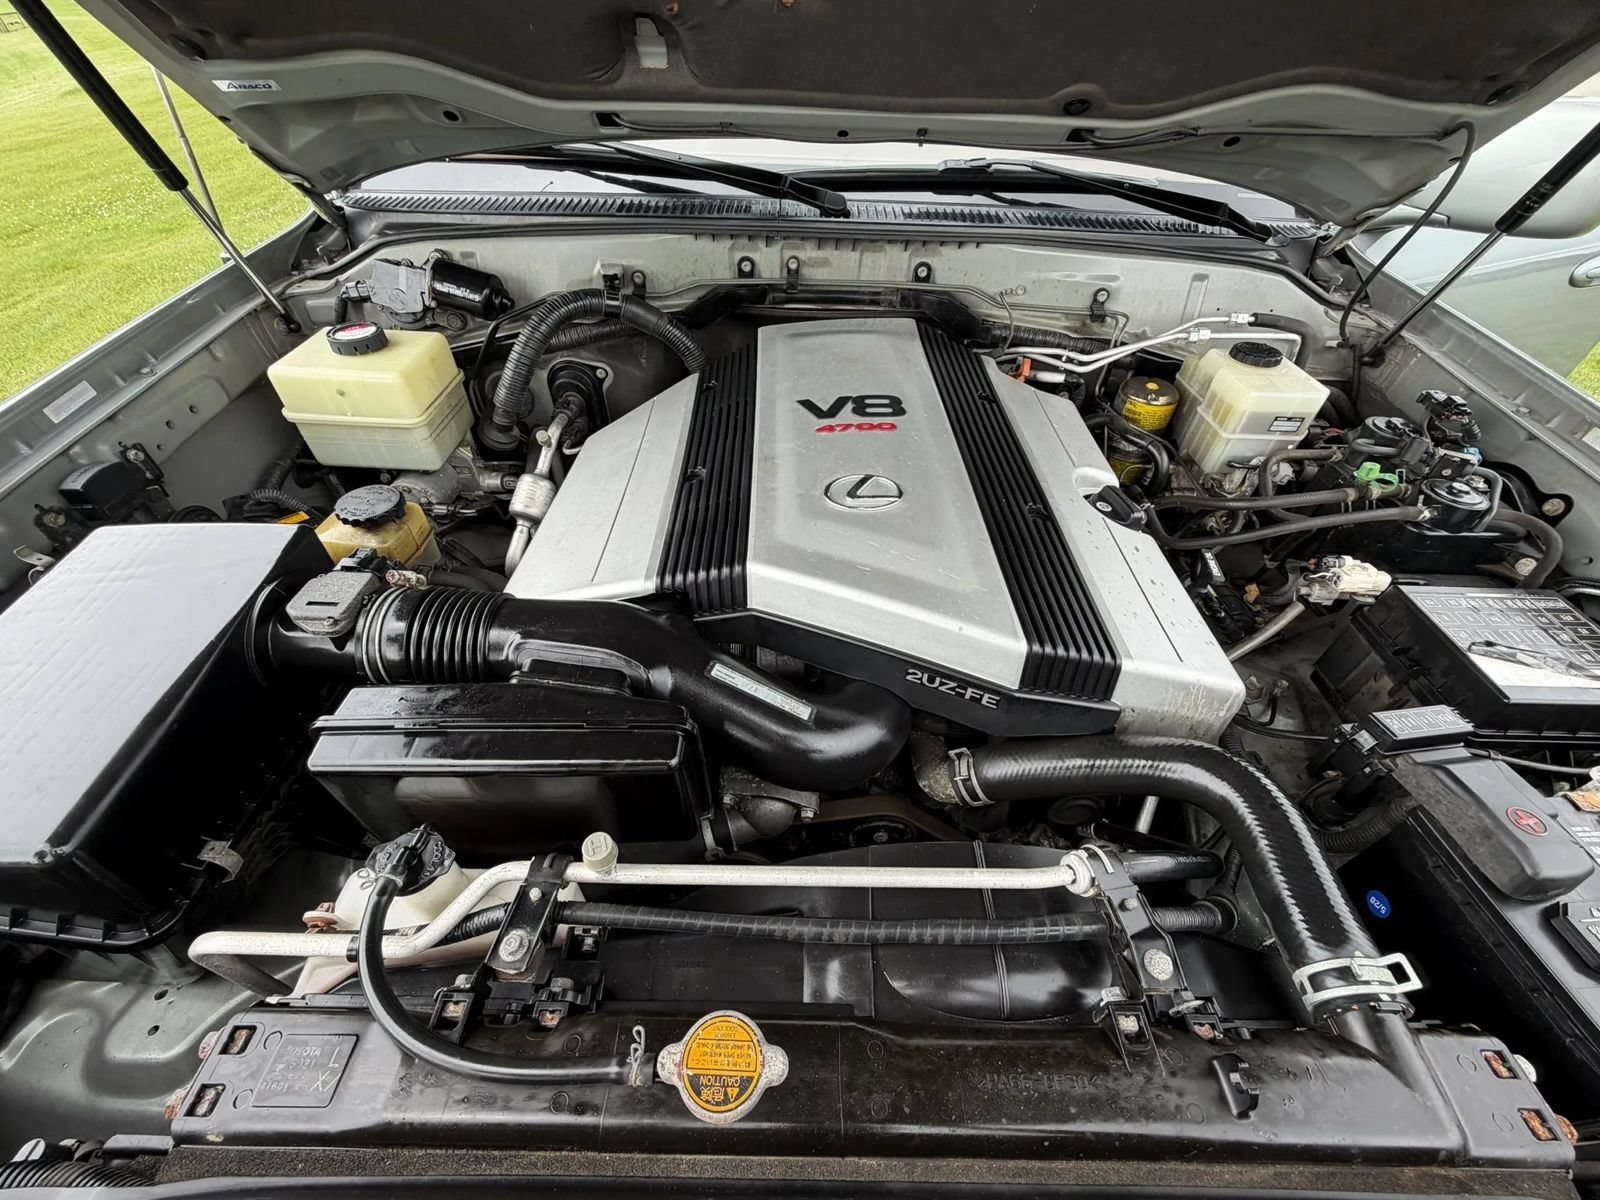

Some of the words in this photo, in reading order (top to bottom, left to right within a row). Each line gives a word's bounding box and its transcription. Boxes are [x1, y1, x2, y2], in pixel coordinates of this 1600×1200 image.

[796, 395, 907, 420] V8
[815, 422, 897, 433] 4700
[905, 668, 1000, 709] 2UZ-FE
[1370, 896, 1387, 915] 5/20
[700, 1075, 740, 1087] CAUTION
